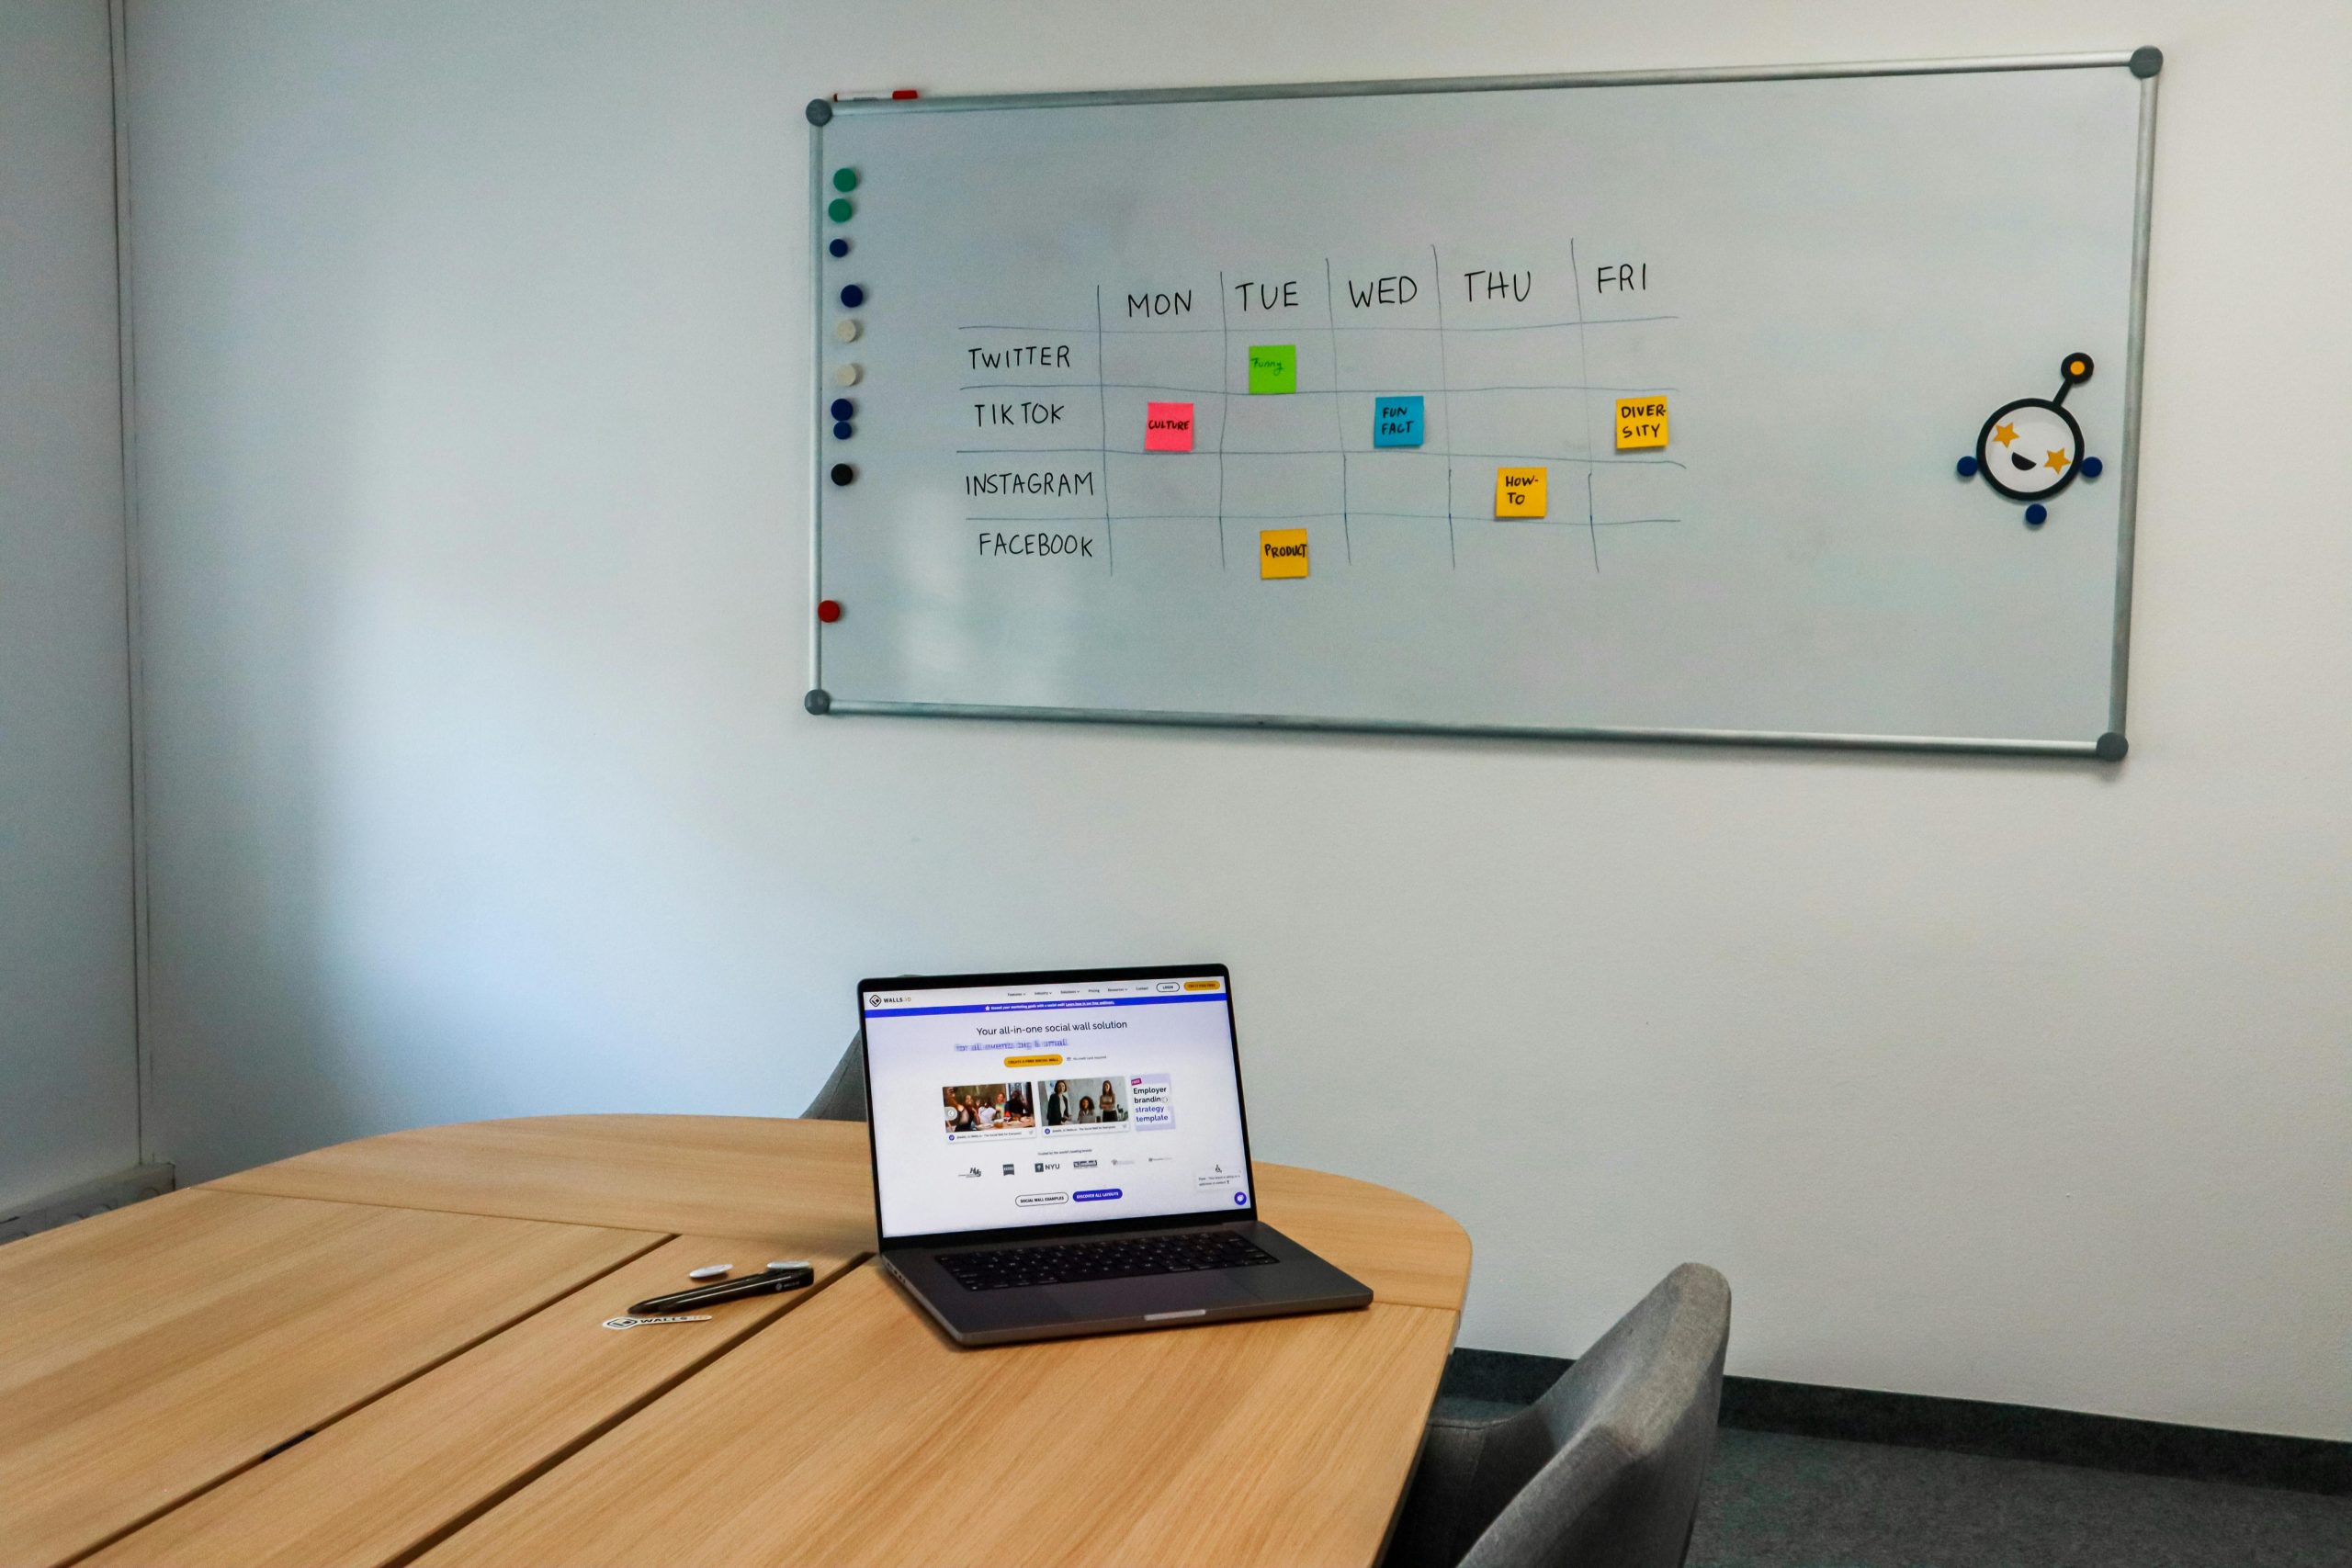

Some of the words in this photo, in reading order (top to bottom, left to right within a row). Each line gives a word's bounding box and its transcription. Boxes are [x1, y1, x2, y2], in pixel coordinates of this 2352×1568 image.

[1127, 288, 1192, 318] MON
[1235, 281, 1298, 311] TUE
[1349, 276, 1418, 309] WED
[1464, 270, 1532, 302] THU
[1597, 263, 1646, 294] FRI
[967, 345, 1070, 369] TWITTER
[1383, 406, 1408, 419] FUN
[1621, 403, 1667, 419] DIVER-
[1148, 419, 1191, 431] CULTURE
[1381, 420, 1415, 435] FACT
[1622, 423, 1661, 439] SITY
[966, 471, 1094, 498] INSTAGRAM
[1505, 474, 1539, 488] HOW-
[1506, 491, 1525, 505] TO
[978, 532, 1093, 558] FACEBOOK
[1264, 543, 1307, 558] PRODUCT
[976, 1027, 996, 1036] Your
[999, 1025, 1043, 1035] all-in-one
[1045, 1023, 1071, 1032] social
[1072, 1021, 1091, 1031] wall
[1092, 1020, 1127, 1030] solution
[1133, 1087, 1167, 1095] Employer
[1134, 1096, 1168, 1104] brandin
[1136, 1114, 1169, 1122] template
